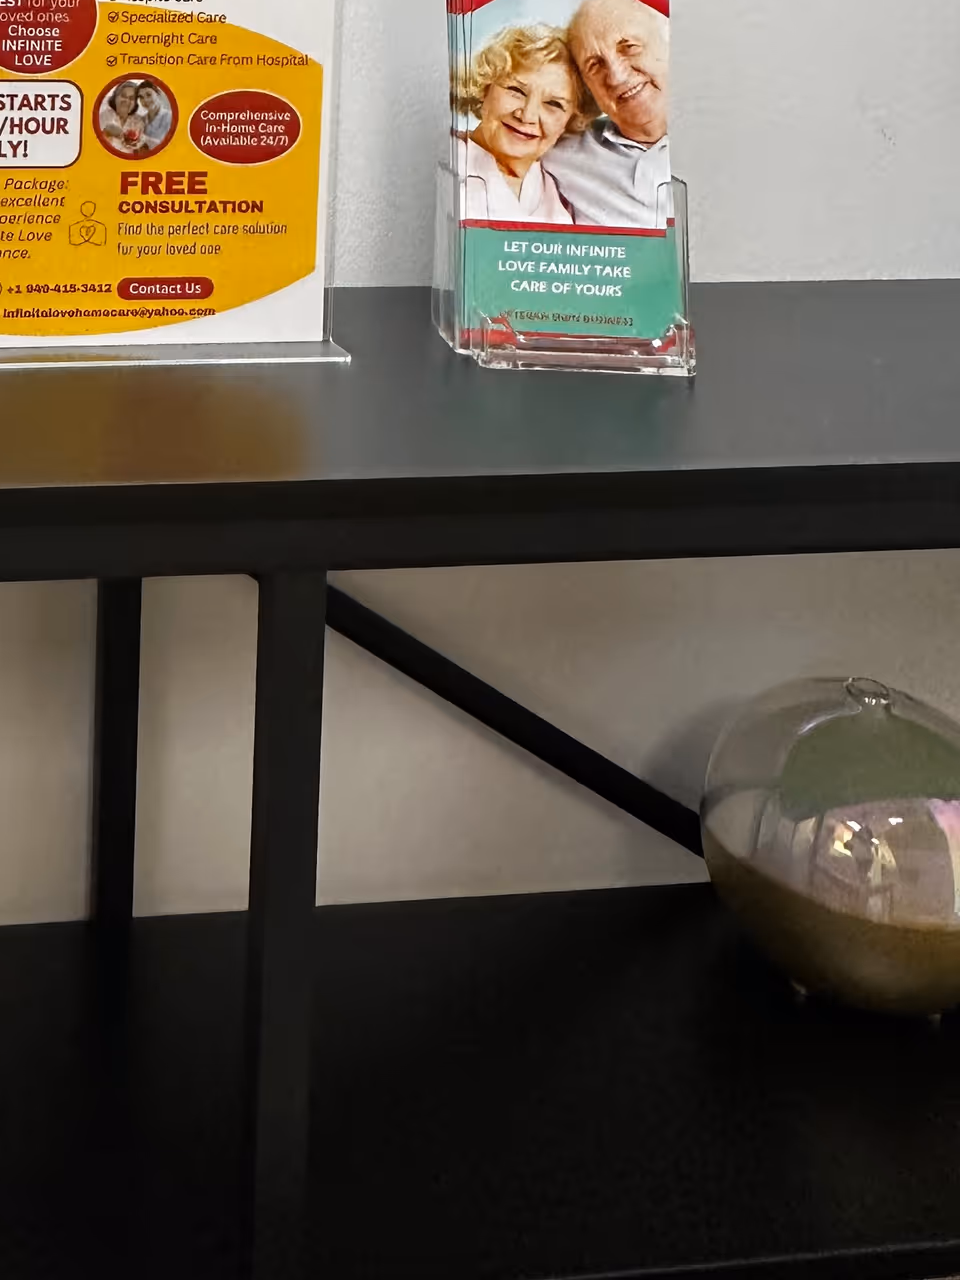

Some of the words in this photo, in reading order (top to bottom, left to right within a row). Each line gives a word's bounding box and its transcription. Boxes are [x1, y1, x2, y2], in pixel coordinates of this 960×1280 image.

[121, 10, 193, 25] Specialized
[197, 12, 227, 23] Care
[8, 24, 60, 37] Choose
[2, 40, 62, 51] INFINITE
[121, 32, 184, 47] Overnight
[188, 33, 217, 44] Care
[15, 54, 52, 65] LOVE
[120, 53, 183, 66] Transition
[187, 54, 216, 65] Care
[220, 54, 253, 66] From
[256, 54, 309, 68] Hospital
[200, 110, 291, 122] Comprehensive
[206, 123, 255, 134] In-Home
[258, 123, 285, 133] Care
[200, 135, 257, 146] (Available
[261, 136, 289, 146] 24/7)
[120, 171, 208, 195] FREE
[1, 195, 65, 207] excellent
[118, 200, 264, 214] CONSULTATION
[18, 230, 52, 241] Love
[118, 222, 142, 235] Find
[147, 222, 164, 235] the
[168, 222, 209, 237] perfect
[213, 223, 239, 234] care
[242, 221, 287, 234] solution
[137, 244, 162, 258] your
[166, 243, 196, 255] loved
[504, 241, 528, 253] LET
[531, 242, 562, 255] OUR
[567, 244, 626, 258] INFINITE
[498, 260, 535, 273] LOVE
[539, 262, 591, 275] FAMILY
[594, 265, 631, 278] TAKE
[129, 282, 182, 295] Contact
[185, 283, 202, 294] Us
[511, 280, 546, 292] CARE
[552, 282, 572, 294] OF
[575, 283, 622, 297] YOURS
